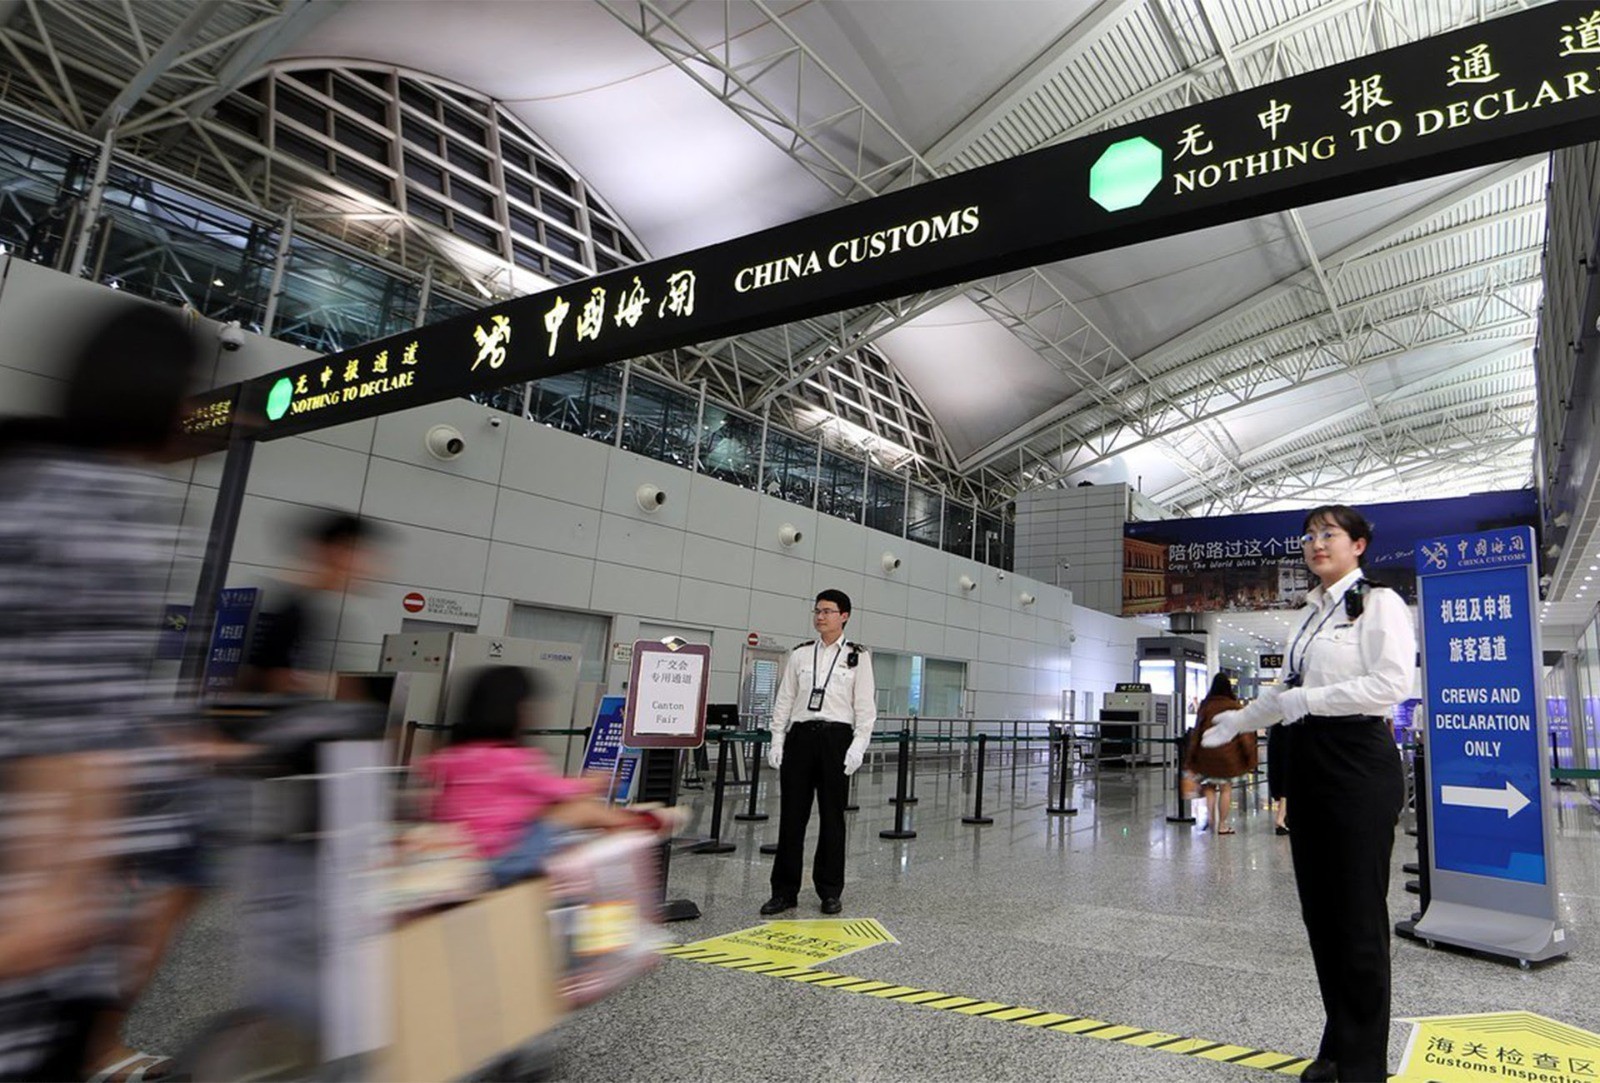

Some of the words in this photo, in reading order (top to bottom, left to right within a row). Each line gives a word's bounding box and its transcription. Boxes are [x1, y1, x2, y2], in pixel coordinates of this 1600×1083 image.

[1173, 10, 1600, 161] 无申报通道
[1173, 135, 1336, 195] NOTHING
[1350, 119, 1403, 151] TO
[1415, 66, 1600, 137] DECLAR
[734, 250, 823, 293] CHINA
[827, 205, 980, 268] CUSTOMS
[294, 341, 418, 394] 无申报通道
[290, 391, 340, 415] NOTHING
[342, 386, 358, 402] TO
[359, 371, 415, 398] DECLARE
[1168, 535, 1306, 562] 陪你路过这个世
[1457, 535, 1525, 560] 中国海关
[1209, 559, 1233, 569] World
[1260, 557, 1276, 567] You
[1457, 557, 1485, 568] CHINA
[1485, 552, 1526, 564] CUSTOMS
[1440, 594, 1513, 624] 机组及申报
[1449, 635, 1508, 663] 旅客通道
[656, 658, 689, 671] 广交会
[652, 672, 692, 685] 专用通道
[652, 700, 685, 711] Canton
[1441, 688, 1488, 704] CREWS
[1490, 687, 1521, 704] AND
[656, 714, 678, 724] Fair
[1435, 714, 1531, 732] DECLARATION
[1464, 740, 1501, 757] ONLY
[1424, 1052, 1497, 1074] Customs
[1426, 1036, 1599, 1077] 海关检查区
